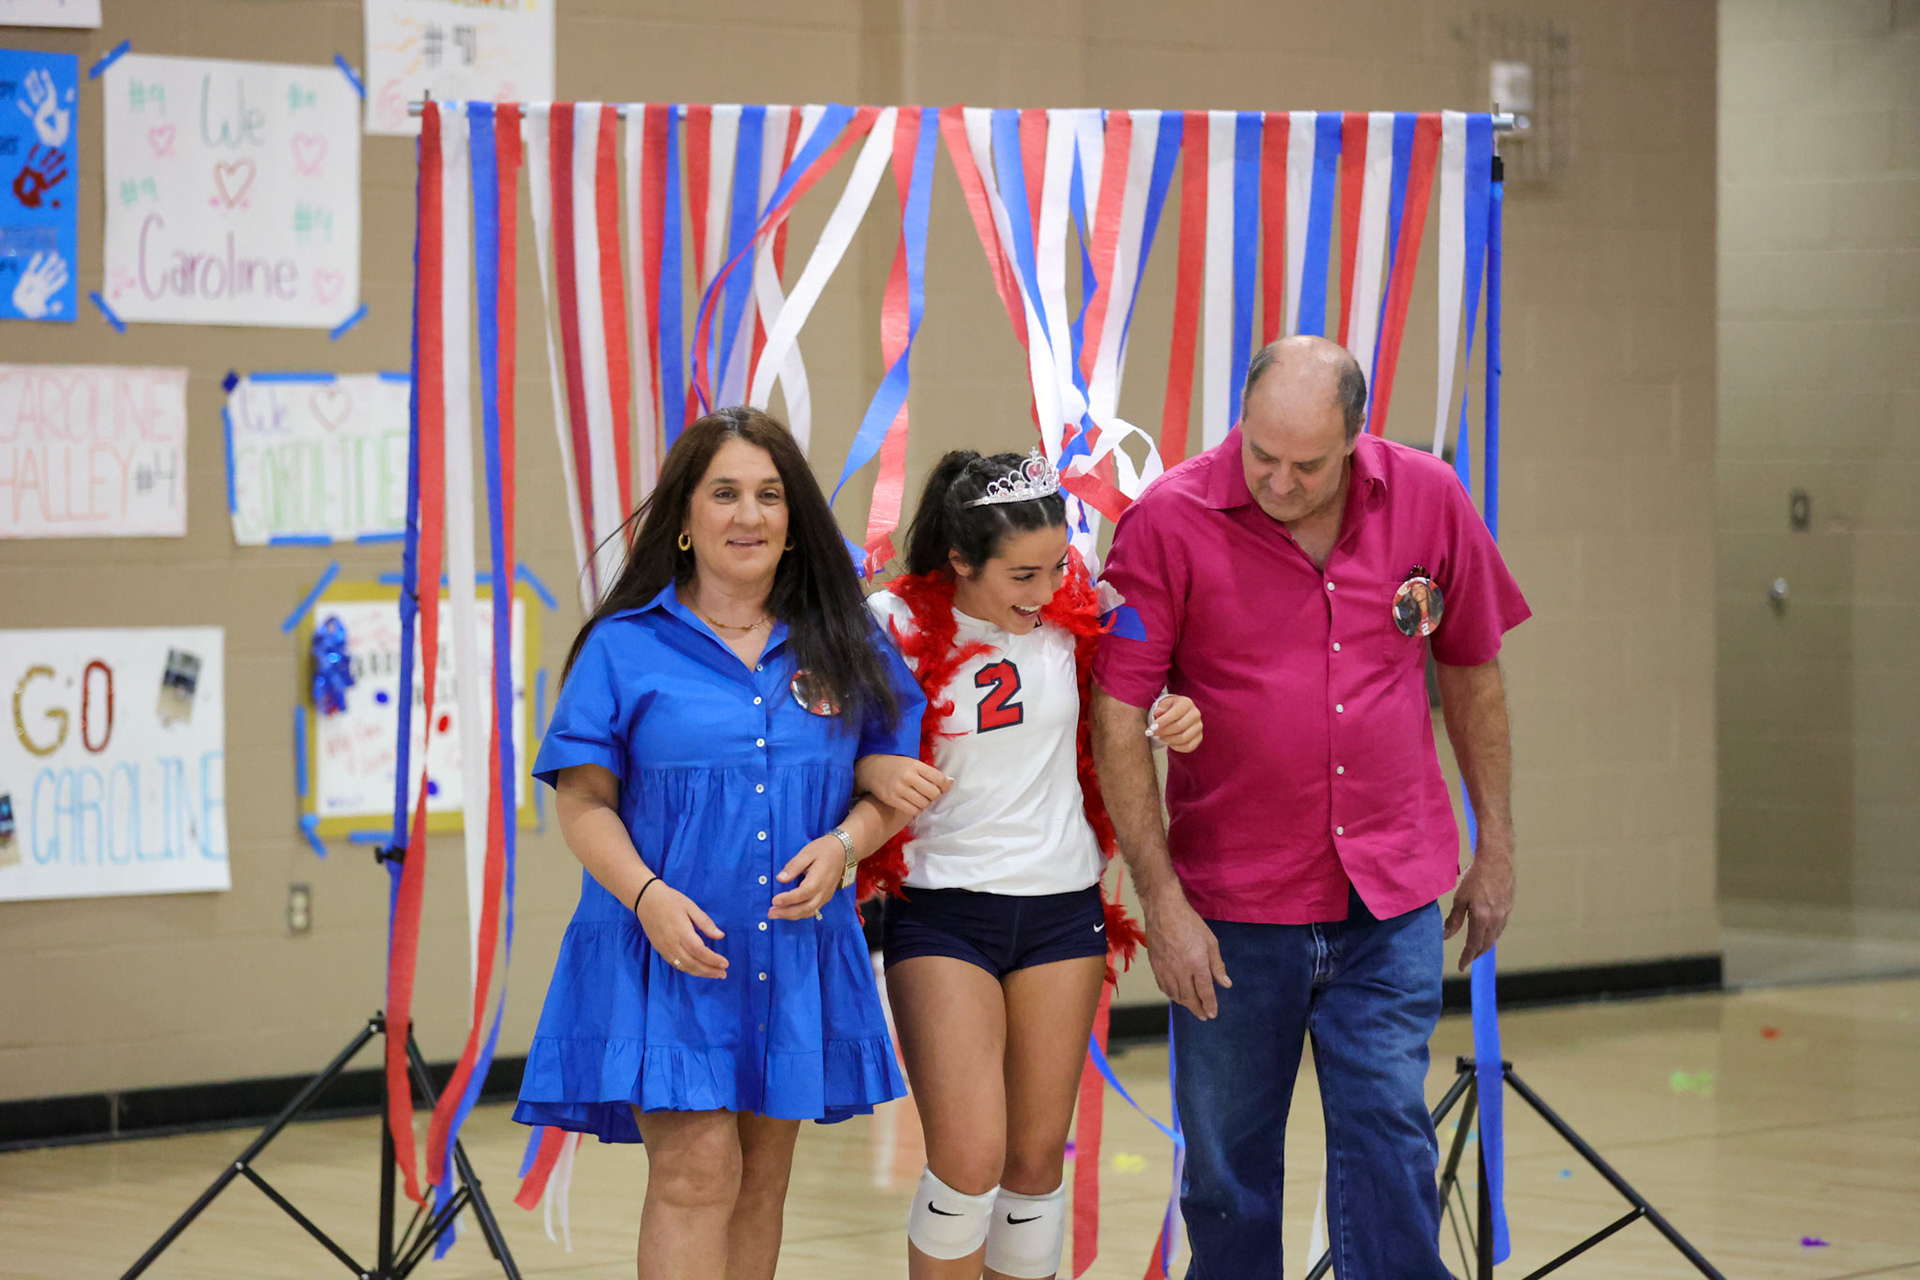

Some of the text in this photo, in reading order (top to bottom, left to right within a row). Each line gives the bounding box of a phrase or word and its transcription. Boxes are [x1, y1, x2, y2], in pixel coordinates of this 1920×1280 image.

[200, 72, 265, 148] We
[138, 212, 299, 301] Caroline
[135, 450, 177, 508] #4
[13, 660, 114, 757] GO
[974, 658, 1024, 734] 2
[31, 749, 225, 867] CAROLINE
